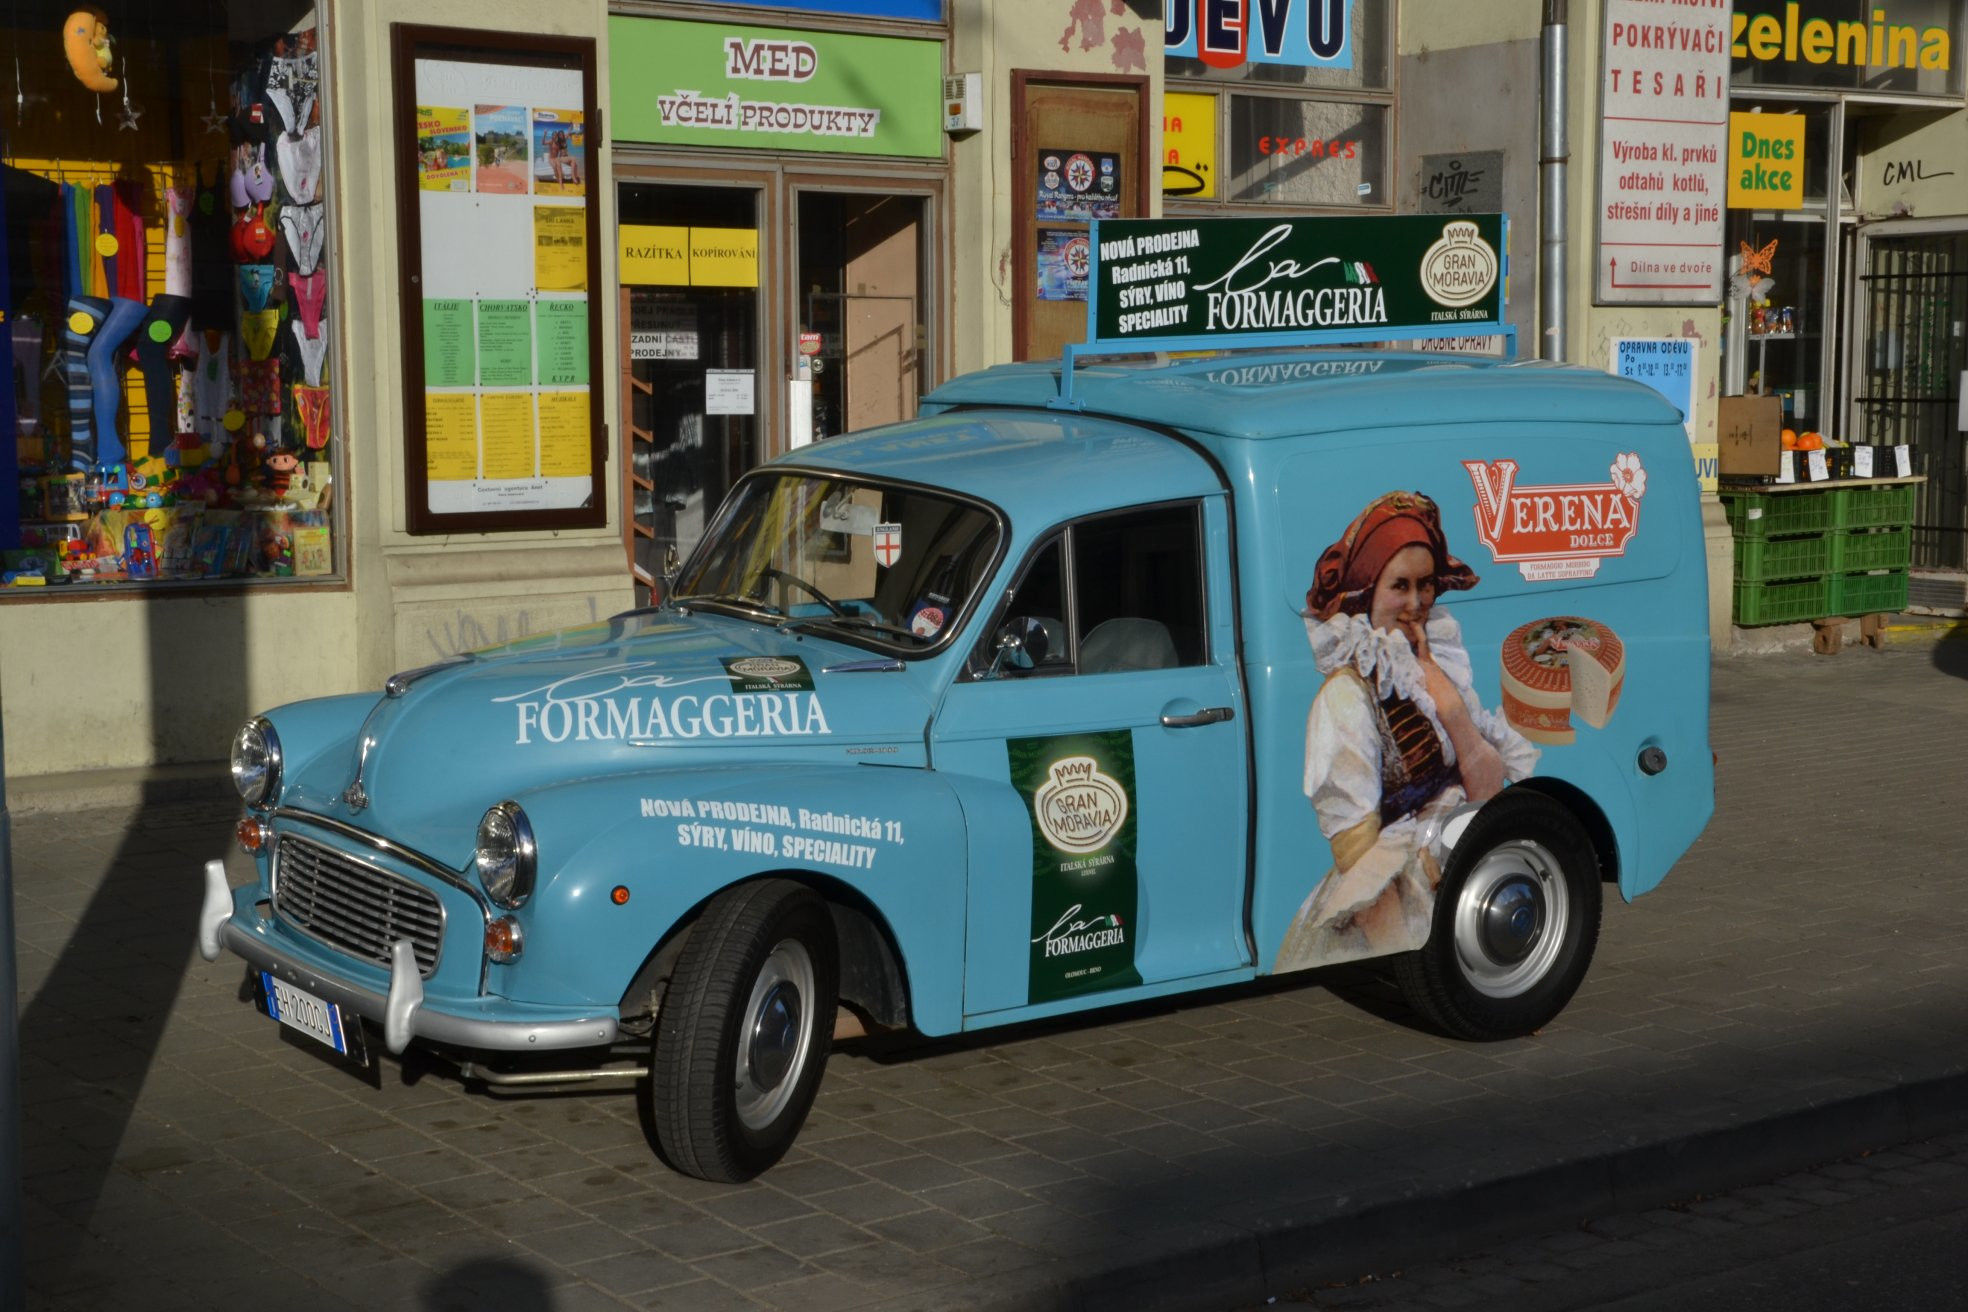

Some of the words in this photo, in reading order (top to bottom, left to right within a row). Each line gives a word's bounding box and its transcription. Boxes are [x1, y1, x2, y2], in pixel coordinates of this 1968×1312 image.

[1613, 21, 1723, 54] POKRÝVAČI
[1731, 2, 1950, 71] zelenina
[728, 40, 818, 80] MED
[1611, 69, 1721, 99] TESAŘI
[657, 93, 734, 126] VČELÍ
[740, 104, 877, 134] PRODUKTY
[1258, 136, 1356, 159] EXPRES
[1613, 140, 1657, 163] Výroba
[1662, 143, 1677, 161] kl.
[1682, 144, 1716, 166] prvků
[1742, 131, 1795, 160] Dnes
[1619, 171, 1664, 190] odtahů
[1673, 173, 1709, 196] kotlů,
[1740, 163, 1792, 191] akce
[1607, 201, 1651, 221] střešní
[1656, 202, 1679, 225] díly
[1683, 207, 1691, 221] a
[1695, 203, 1718, 225] jiné
[625, 244, 683, 260] RAZÍTKA
[692, 244, 756, 260] KOPÍROVÁNÍ
[1100, 235, 1135, 261] NOVÁ
[1136, 229, 1200, 256] PRODEJNA
[1112, 257, 1174, 285] Radnická
[1175, 255, 1191, 275] 11,
[1443, 254, 1476, 270] GRAN
[1631, 261, 1660, 273] Dílna
[1664, 264, 1676, 273] ve
[1680, 262, 1712, 273] dvoře
[1433, 271, 1485, 288] MORAVIA
[1119, 285, 1154, 309] SÝRY,
[1154, 280, 1186, 302] VÍNO
[1119, 304, 1188, 333] SPECIALITY
[1205, 287, 1388, 331] FORMAGGERIA
[1431, 309, 1458, 322] ITALSKÁ
[1459, 308, 1488, 320] SÝRÁRNA
[1619, 341, 1657, 354] OPRAVNA
[1625, 354, 1635, 363] Po
[1625, 366, 1633, 376] St
[1463, 460, 1632, 542] VERENA
[1570, 533, 1614, 548] DOLCE
[1530, 562, 1564, 571] FORMAGGIO
[1538, 571, 1556, 579] LATTE
[515, 691, 832, 745] FORMAGGERIA
[1056, 791, 1098, 815] GRAN
[640, 798, 696, 818] NOVÁ
[697, 800, 797, 830] PRODEJNA,
[799, 808, 882, 840] Radnická
[885, 820, 905, 846] 11,
[1053, 809, 1113, 835] MORAVIA
[677, 822, 728, 852] SÝRY,
[731, 826, 779, 858] VÍNO,
[782, 835, 877, 869] SPECIALITY
[1060, 860, 1087, 873] ITALSKÁ
[1088, 855, 1115, 868] SÝRÁRNA
[1044, 927, 1124, 958] FORMAGGERIA
[1064, 969, 1087, 979] OLOMOUC
